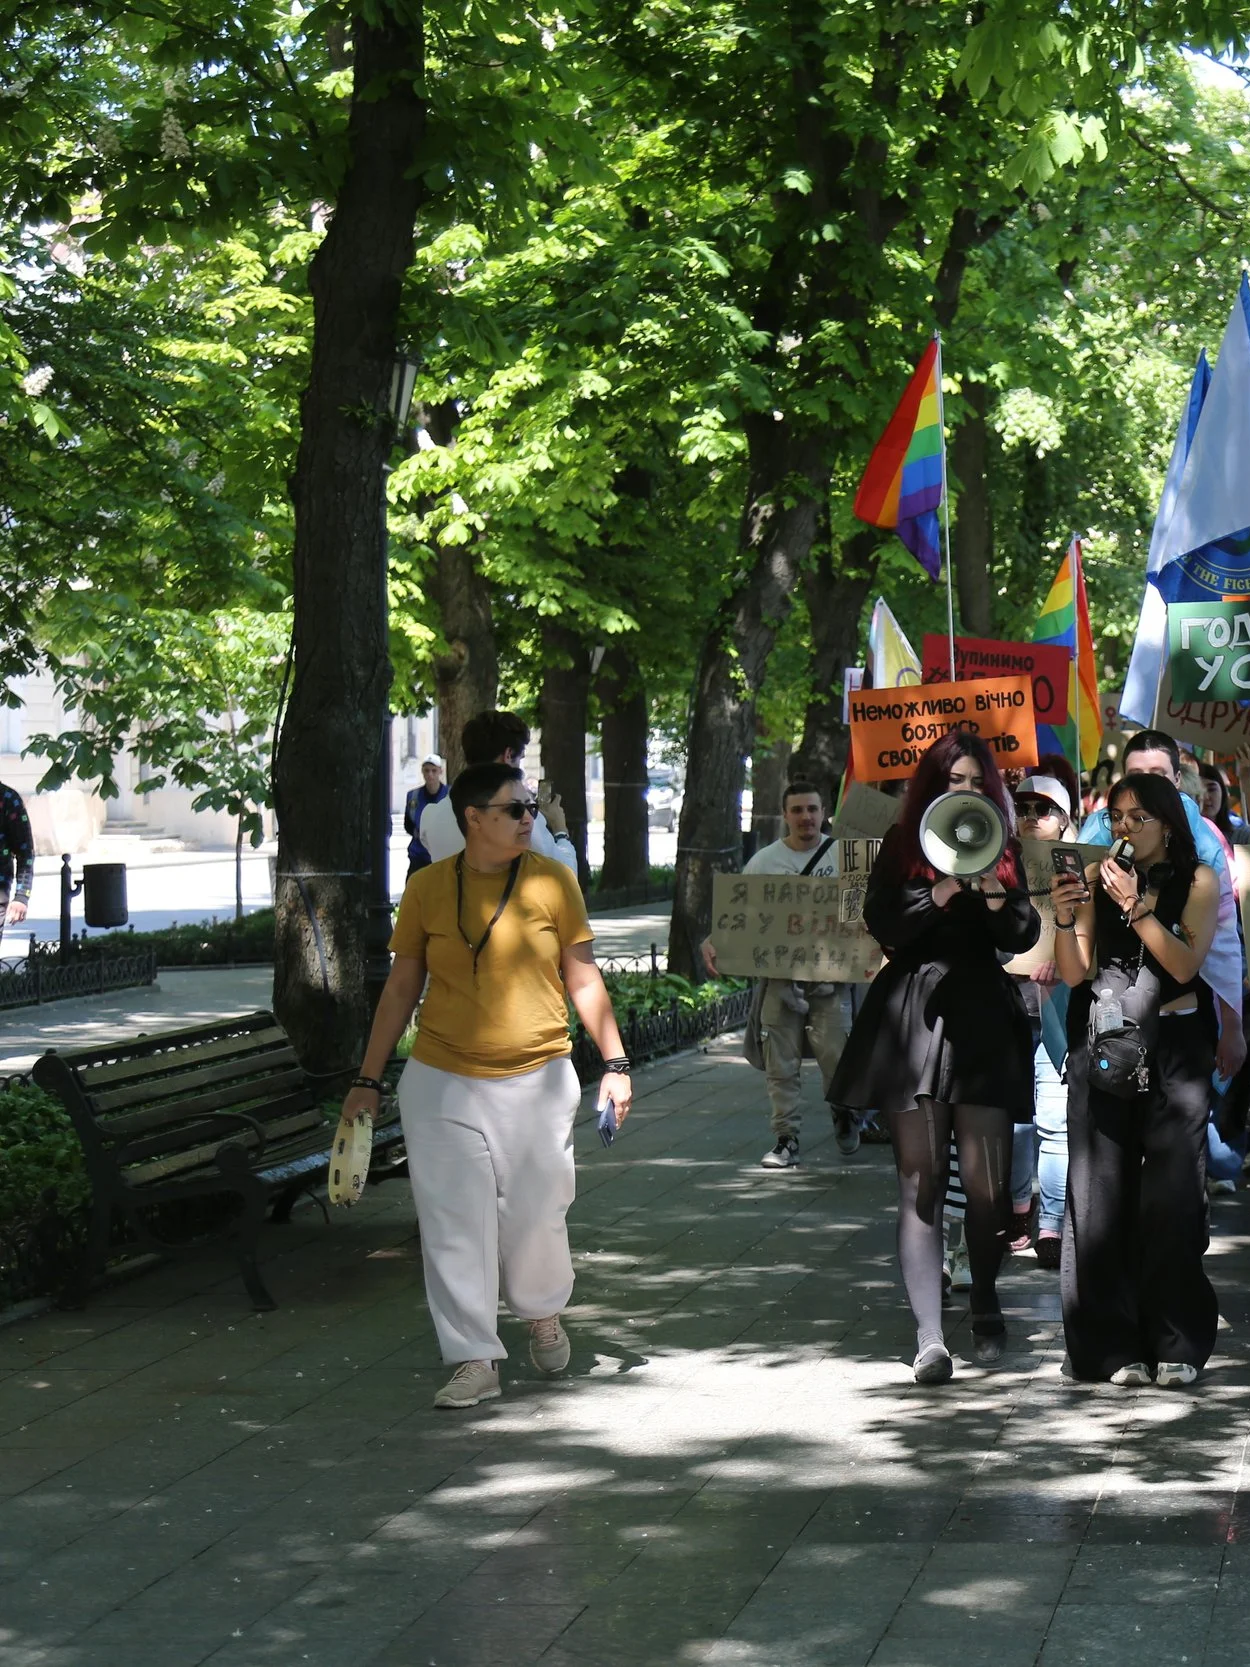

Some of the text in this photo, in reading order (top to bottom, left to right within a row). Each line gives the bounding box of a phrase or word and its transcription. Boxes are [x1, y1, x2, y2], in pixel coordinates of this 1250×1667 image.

[1193, 563, 1219, 587] THE
[1194, 654, 1225, 691] У
[853, 696, 966, 722] Неможливо
[976, 690, 1024, 712] вічно
[730, 882, 839, 905] Я НАРОД
[758, 912, 774, 934] У
